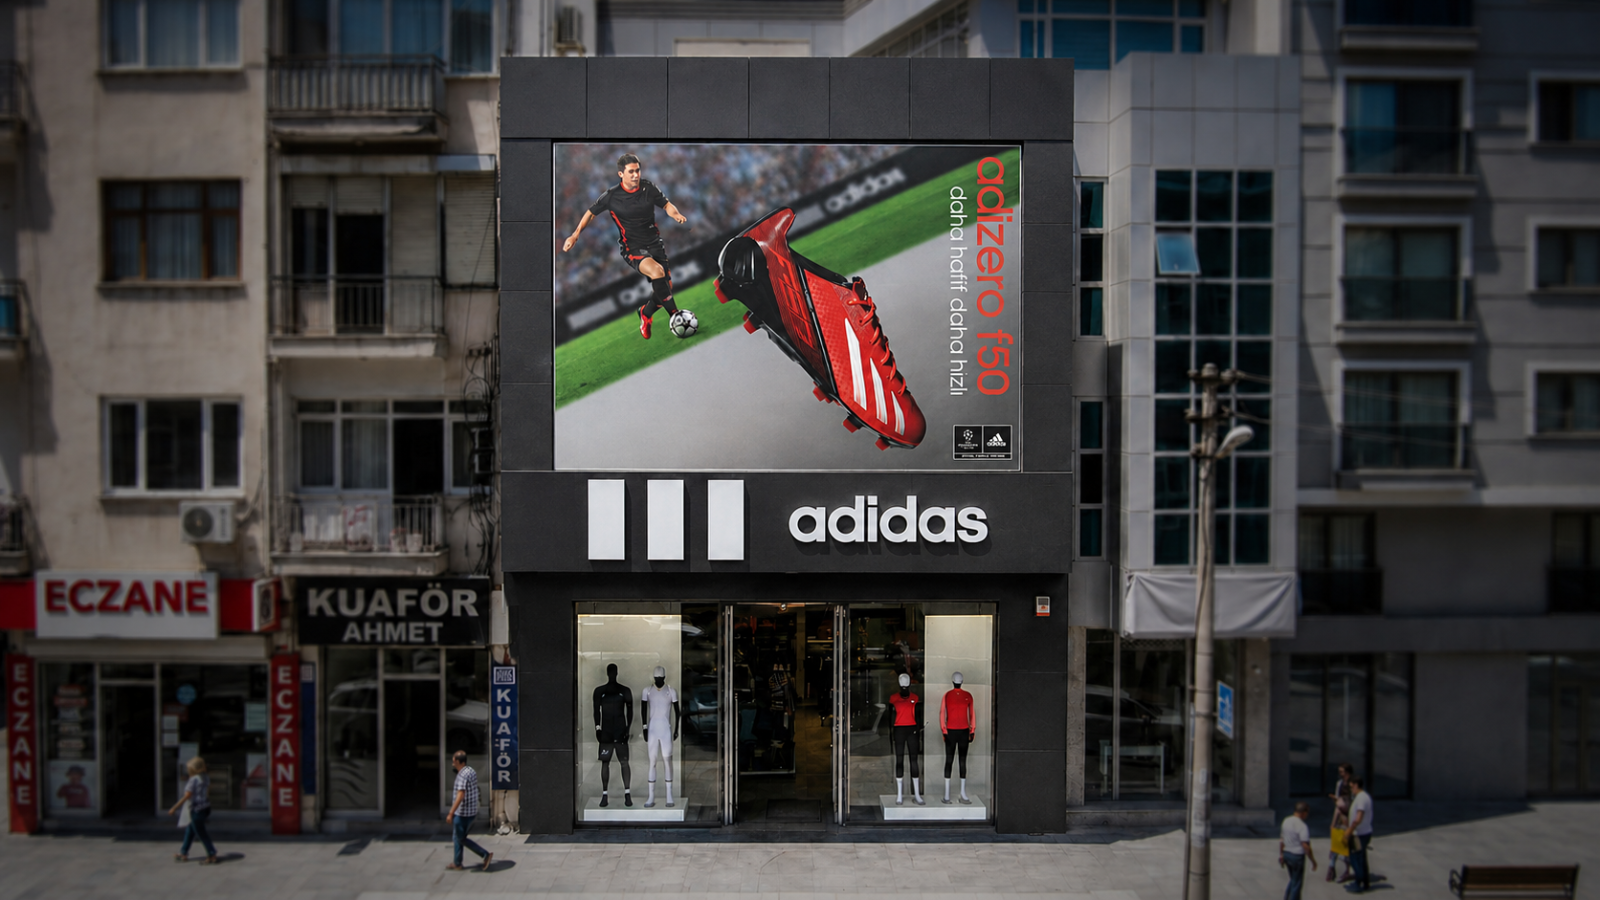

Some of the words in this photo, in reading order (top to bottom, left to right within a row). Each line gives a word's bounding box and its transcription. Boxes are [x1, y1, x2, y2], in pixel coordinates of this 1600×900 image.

[950, 186, 968, 241] daha
[976, 157, 1014, 318] adizero
[950, 247, 968, 292] hafif
[950, 298, 968, 354] daha
[976, 329, 1014, 396] f50
[788, 495, 989, 543] adidas
[45, 579, 208, 614] ECZANE
[307, 582, 480, 617] KUAFÖR
[342, 621, 444, 643] AHMET
[12, 663, 31, 805] ECZANE
[275, 666, 295, 807] ECZANE
[496, 688, 511, 782] KUAFÖR
